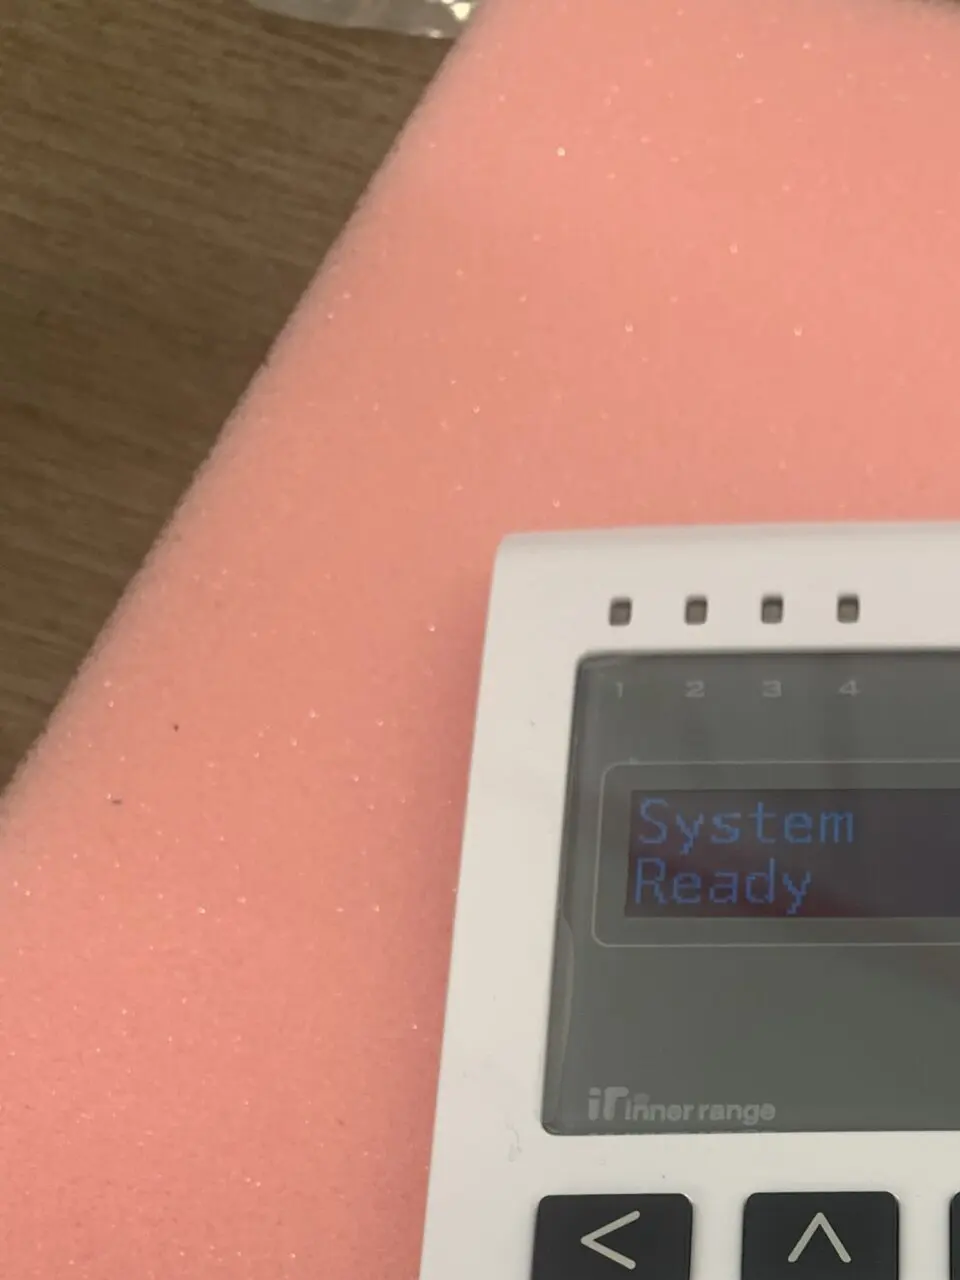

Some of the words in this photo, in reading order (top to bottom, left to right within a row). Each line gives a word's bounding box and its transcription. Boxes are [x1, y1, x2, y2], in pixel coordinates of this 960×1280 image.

[615, 681, 624, 698] 1
[685, 679, 705, 698] 2
[762, 679, 782, 698] 3
[838, 679, 859, 697] 4
[638, 797, 854, 855] System
[634, 856, 812, 915] Ready
[624, 1096, 695, 1122] inner
[699, 1102, 776, 1126] range
